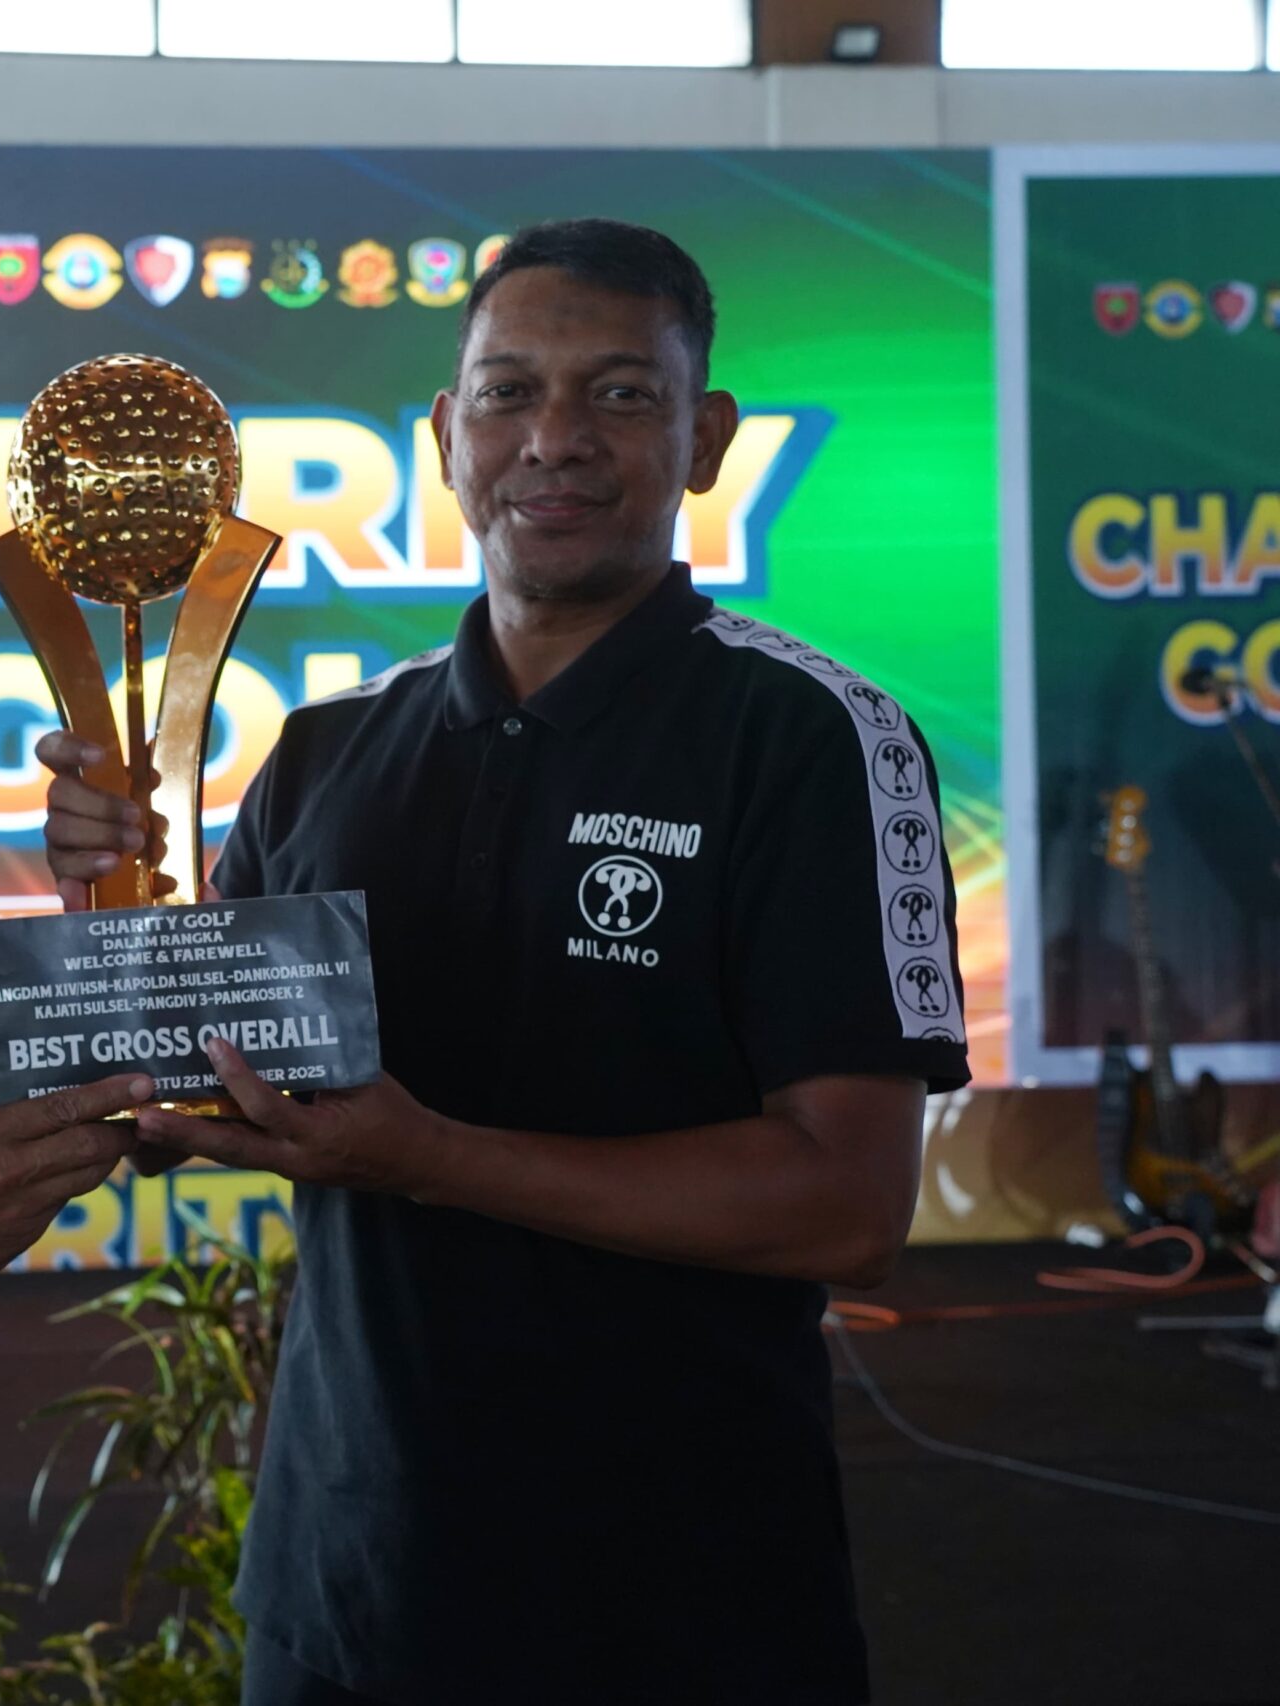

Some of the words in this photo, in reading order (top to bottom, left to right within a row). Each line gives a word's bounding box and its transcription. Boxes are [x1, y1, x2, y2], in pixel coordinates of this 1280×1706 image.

[568, 812, 702, 859] MOSCHINO
[88, 914, 178, 936] CHARITY
[183, 911, 236, 929] GOLF
[103, 935, 157, 951] DALAM
[160, 931, 224, 947] RANGKA
[567, 937, 659, 967] MILANO
[64, 951, 153, 971] WELCOME
[156, 950, 170, 963] &
[173, 943, 267, 963] FAREWELL
[335, 961, 350, 975] VI
[35, 1003, 82, 1019] KAJATI
[84, 993, 197, 1015] SULSEL-PANGDIV
[199, 986, 293, 1006] 3-PANGKOSEK
[295, 985, 304, 998] 2
[9, 1034, 84, 1071] BEST
[91, 1025, 192, 1063] GROSS
[198, 1015, 339, 1054] OVERALL
[183, 1075, 201, 1088] 22
[288, 1065, 326, 1080] 2025
